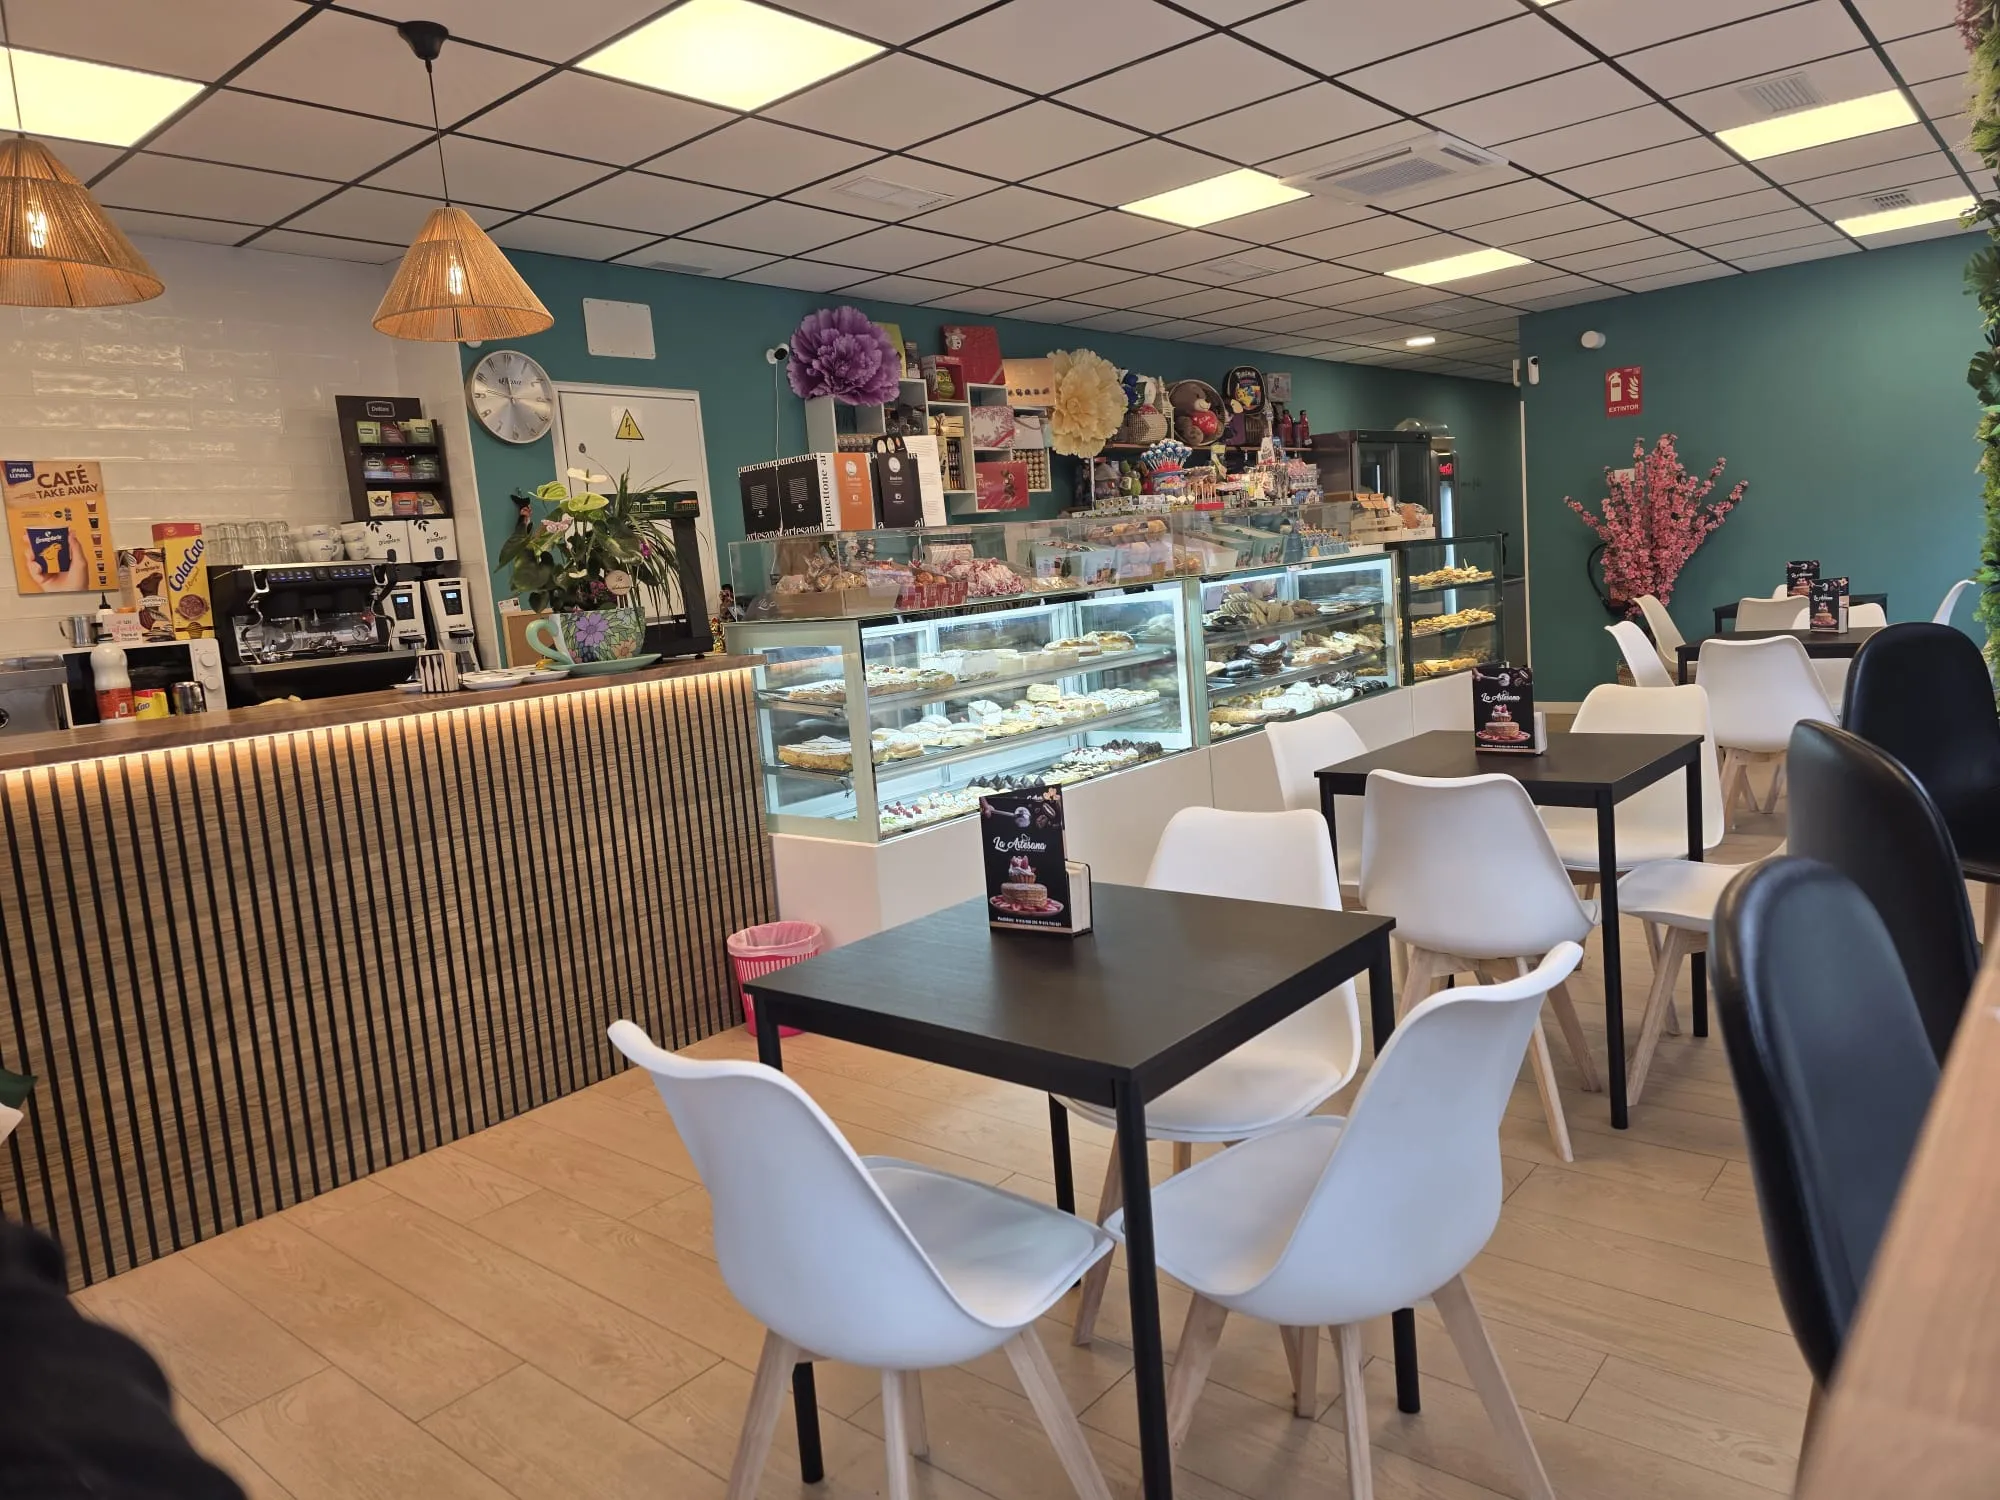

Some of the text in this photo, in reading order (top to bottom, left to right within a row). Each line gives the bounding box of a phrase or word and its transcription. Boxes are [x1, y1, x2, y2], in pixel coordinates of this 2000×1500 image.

[1608, 403, 1640, 413] EXTINTOR
[36, 464, 89, 489] CAFÉ
[36, 488, 66, 500] TAKE
[67, 483, 99, 497] AWAY
[746, 526, 783, 541] artesanal
[784, 522, 824, 537] artesanal
[168, 538, 205, 592] ColaCao
[1481, 692, 1493, 703] La
[993, 836, 1047, 853] La Artesana
